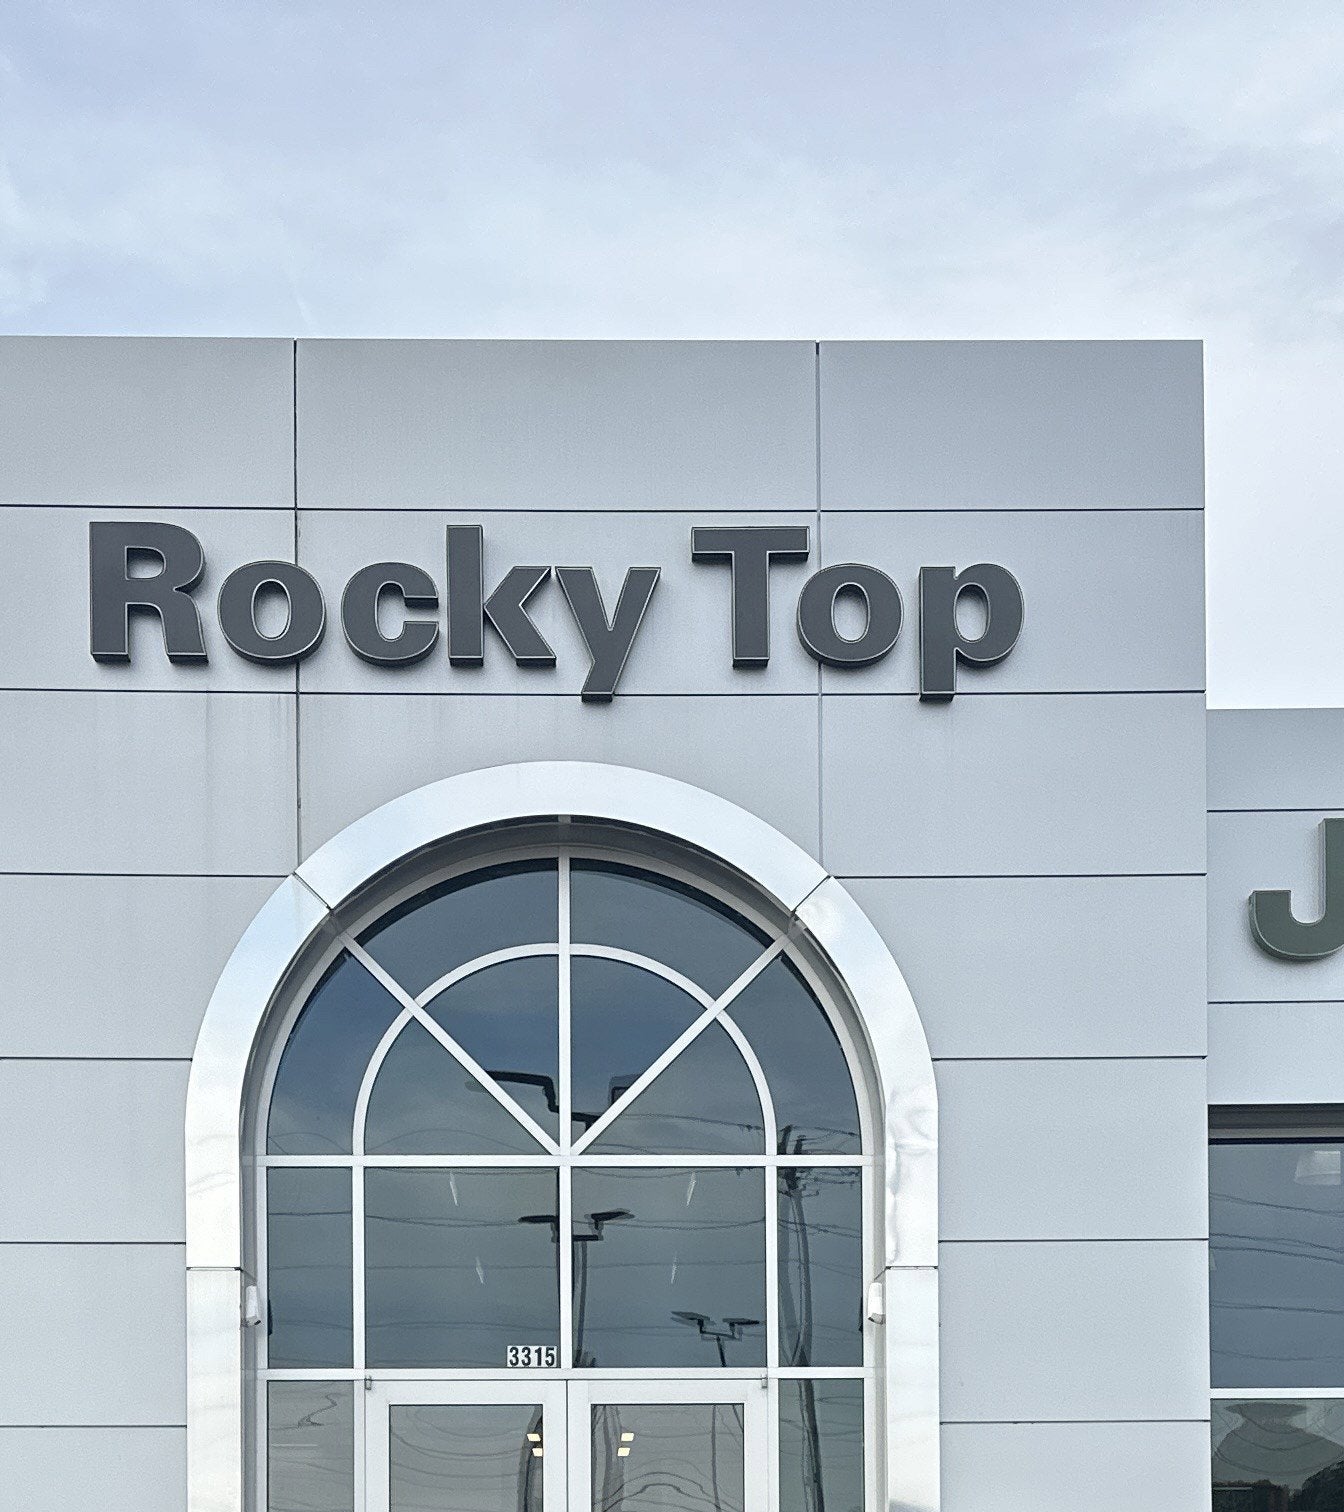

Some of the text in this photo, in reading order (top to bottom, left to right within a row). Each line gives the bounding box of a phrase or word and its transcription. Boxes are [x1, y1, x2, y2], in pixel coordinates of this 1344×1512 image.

[89, 521, 1026, 702] Rocky Top
[509, 1346, 555, 1367] 3315
